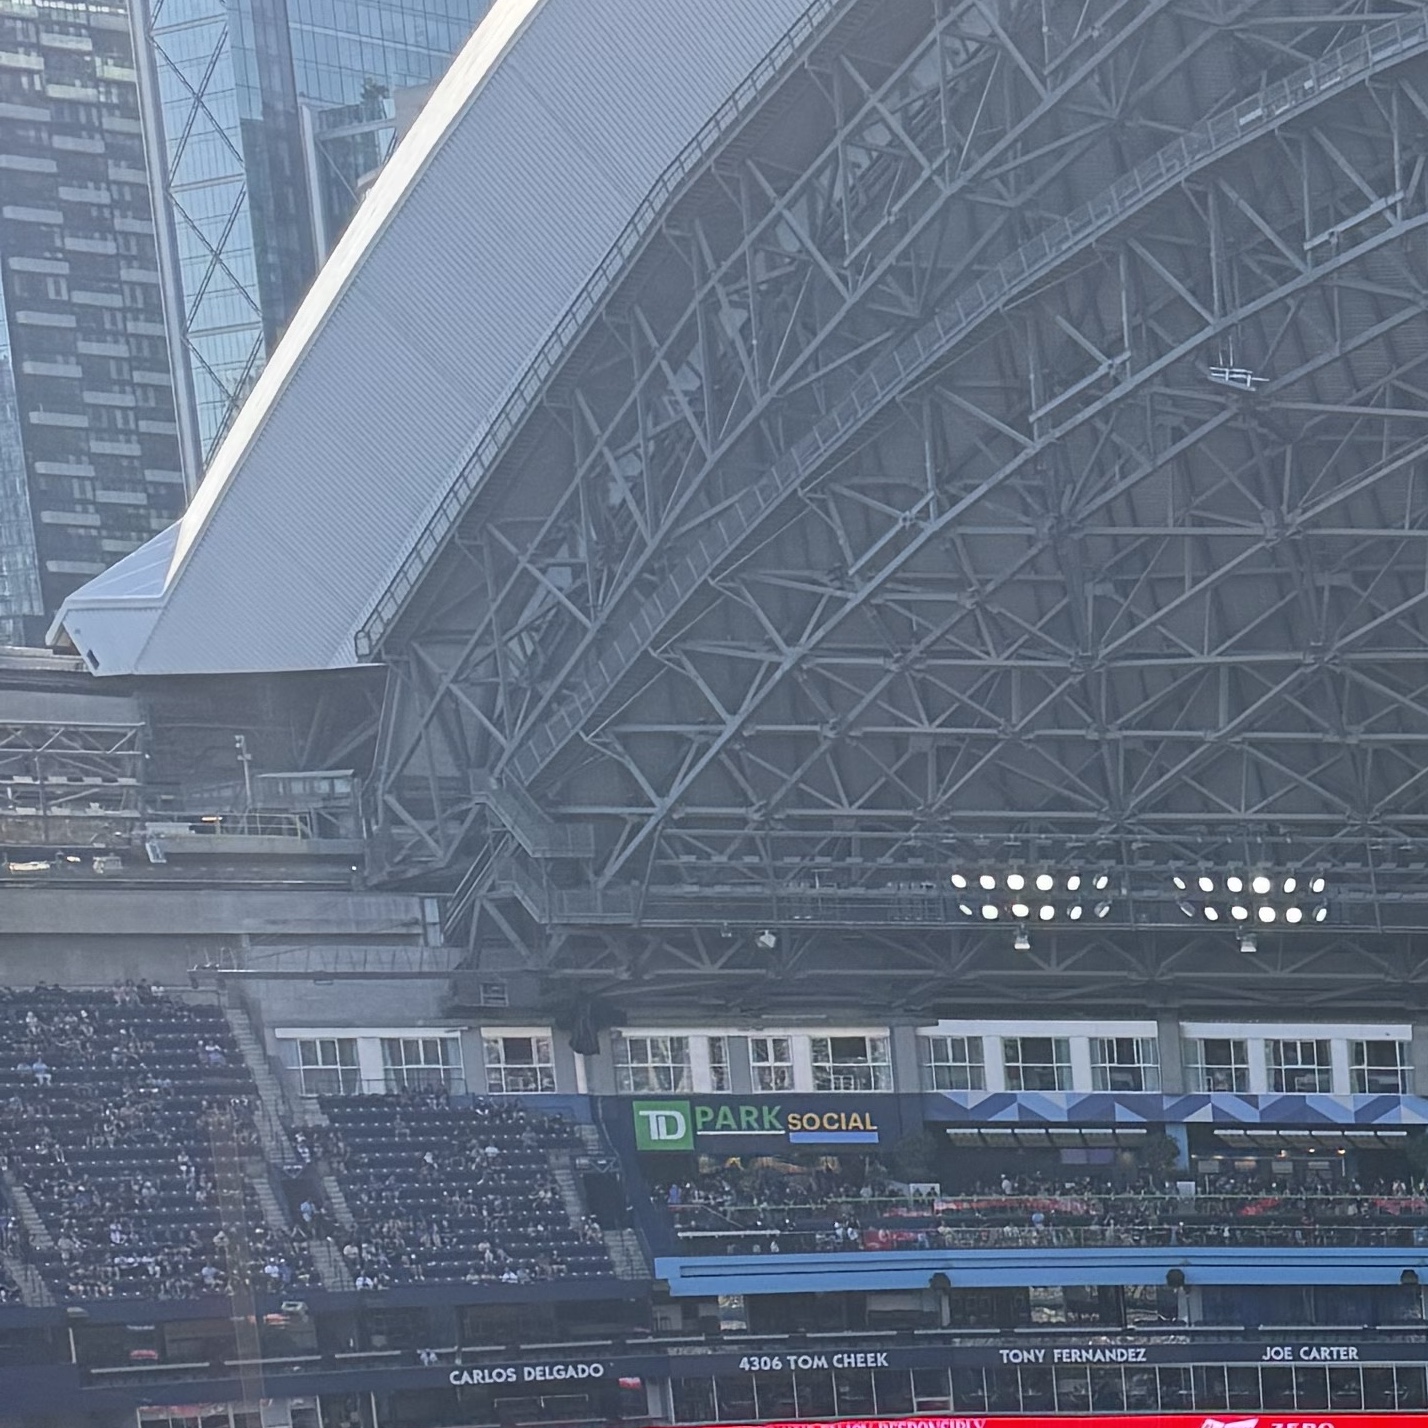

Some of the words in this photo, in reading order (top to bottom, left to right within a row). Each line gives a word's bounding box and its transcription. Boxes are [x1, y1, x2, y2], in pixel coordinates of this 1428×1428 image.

[639, 1110, 687, 1141] TD
[694, 1105, 784, 1131] PARK
[787, 1112, 878, 1131] SOCIAL
[738, 1355, 783, 1371] 4306
[786, 1353, 828, 1370] TOM
[832, 1352, 889, 1368] CHEEK
[999, 1348, 1045, 1364] TONY
[1053, 1347, 1147, 1364] FERNANDEZ
[1262, 1346, 1293, 1361] JOE
[1299, 1345, 1359, 1361] CARTER
[449, 1367, 517, 1386] CARLOS
[524, 1363, 604, 1383] DELGADO
